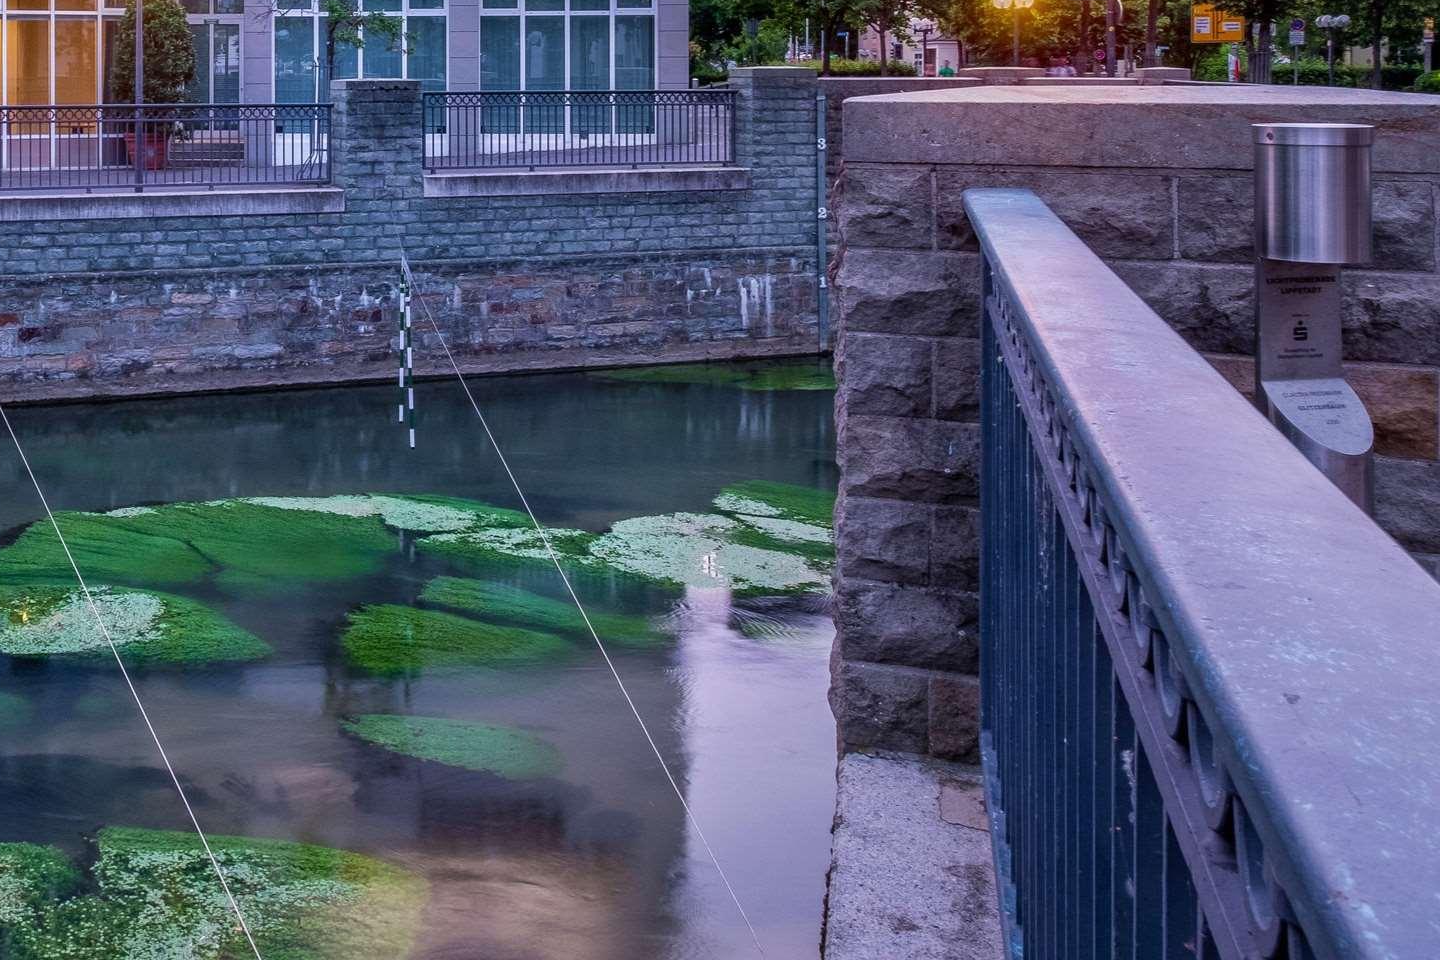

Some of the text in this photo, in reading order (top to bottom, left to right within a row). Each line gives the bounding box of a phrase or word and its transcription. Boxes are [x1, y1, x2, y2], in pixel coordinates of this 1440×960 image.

[817, 138, 826, 150] 3
[817, 207, 827, 219] 2
[819, 276, 827, 288] 1
